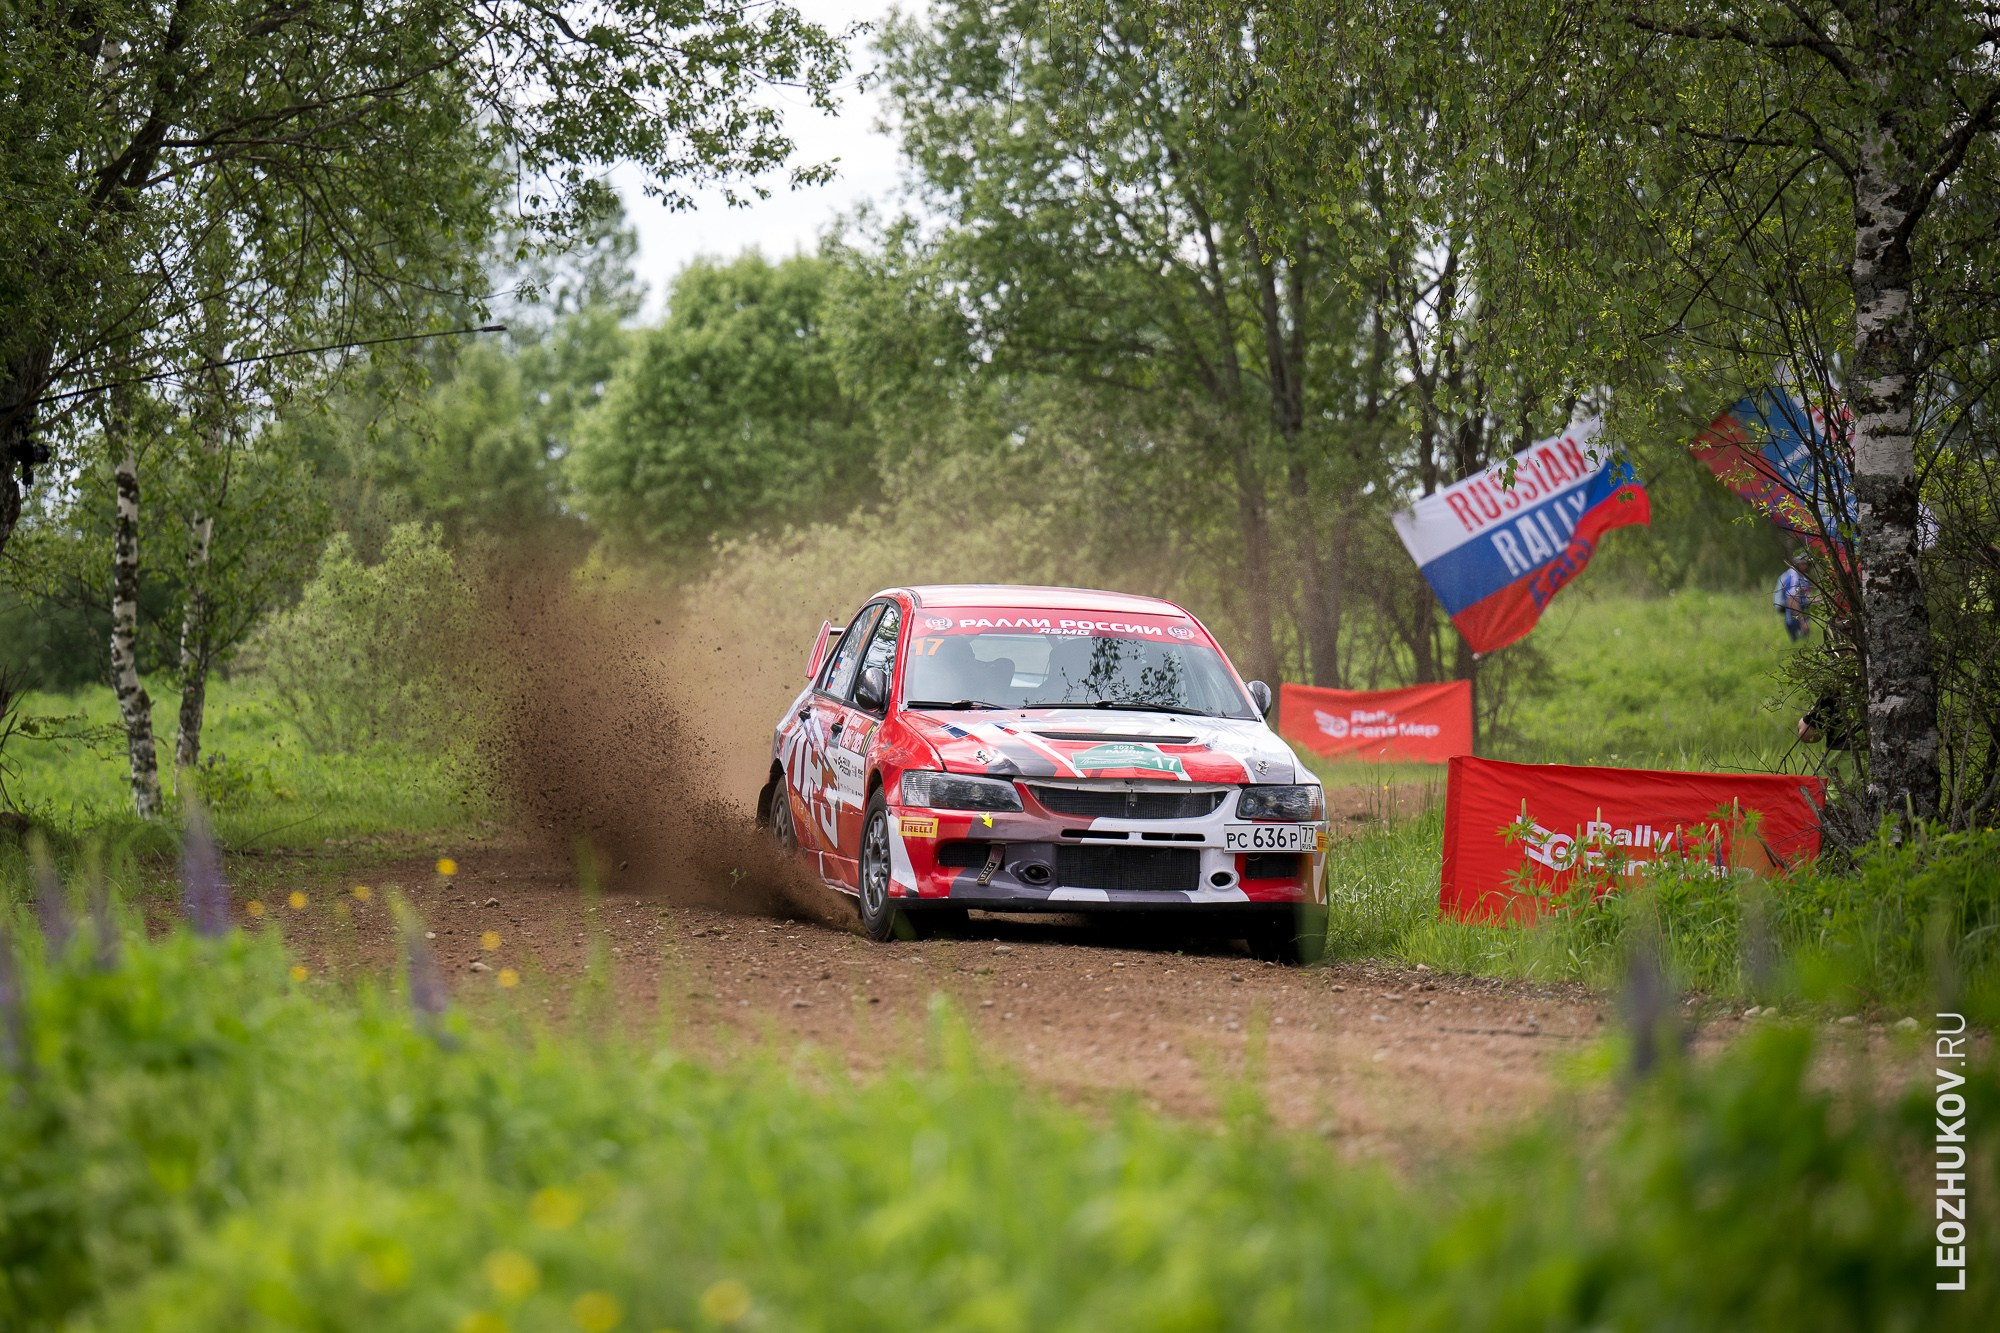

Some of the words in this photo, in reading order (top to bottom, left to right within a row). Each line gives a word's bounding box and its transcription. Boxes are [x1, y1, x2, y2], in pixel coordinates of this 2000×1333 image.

[1445, 436, 1588, 533] RUSSIAN
[1489, 488, 1588, 578] RALLY
[959, 618, 1051, 628] РАЛЛИ
[1060, 619, 1163, 636] РОССИИ
[911, 638, 945, 656] 17
[1351, 710, 1396, 725] Rally
[1351, 723, 1398, 738] Fans
[1399, 722, 1441, 739] Map
[1152, 756, 1178, 771] 17
[900, 819, 934, 834] PIRELLI
[1302, 827, 1314, 844] 77
[1253, 827, 1287, 849] 636
[1586, 820, 1674, 853] Rally
